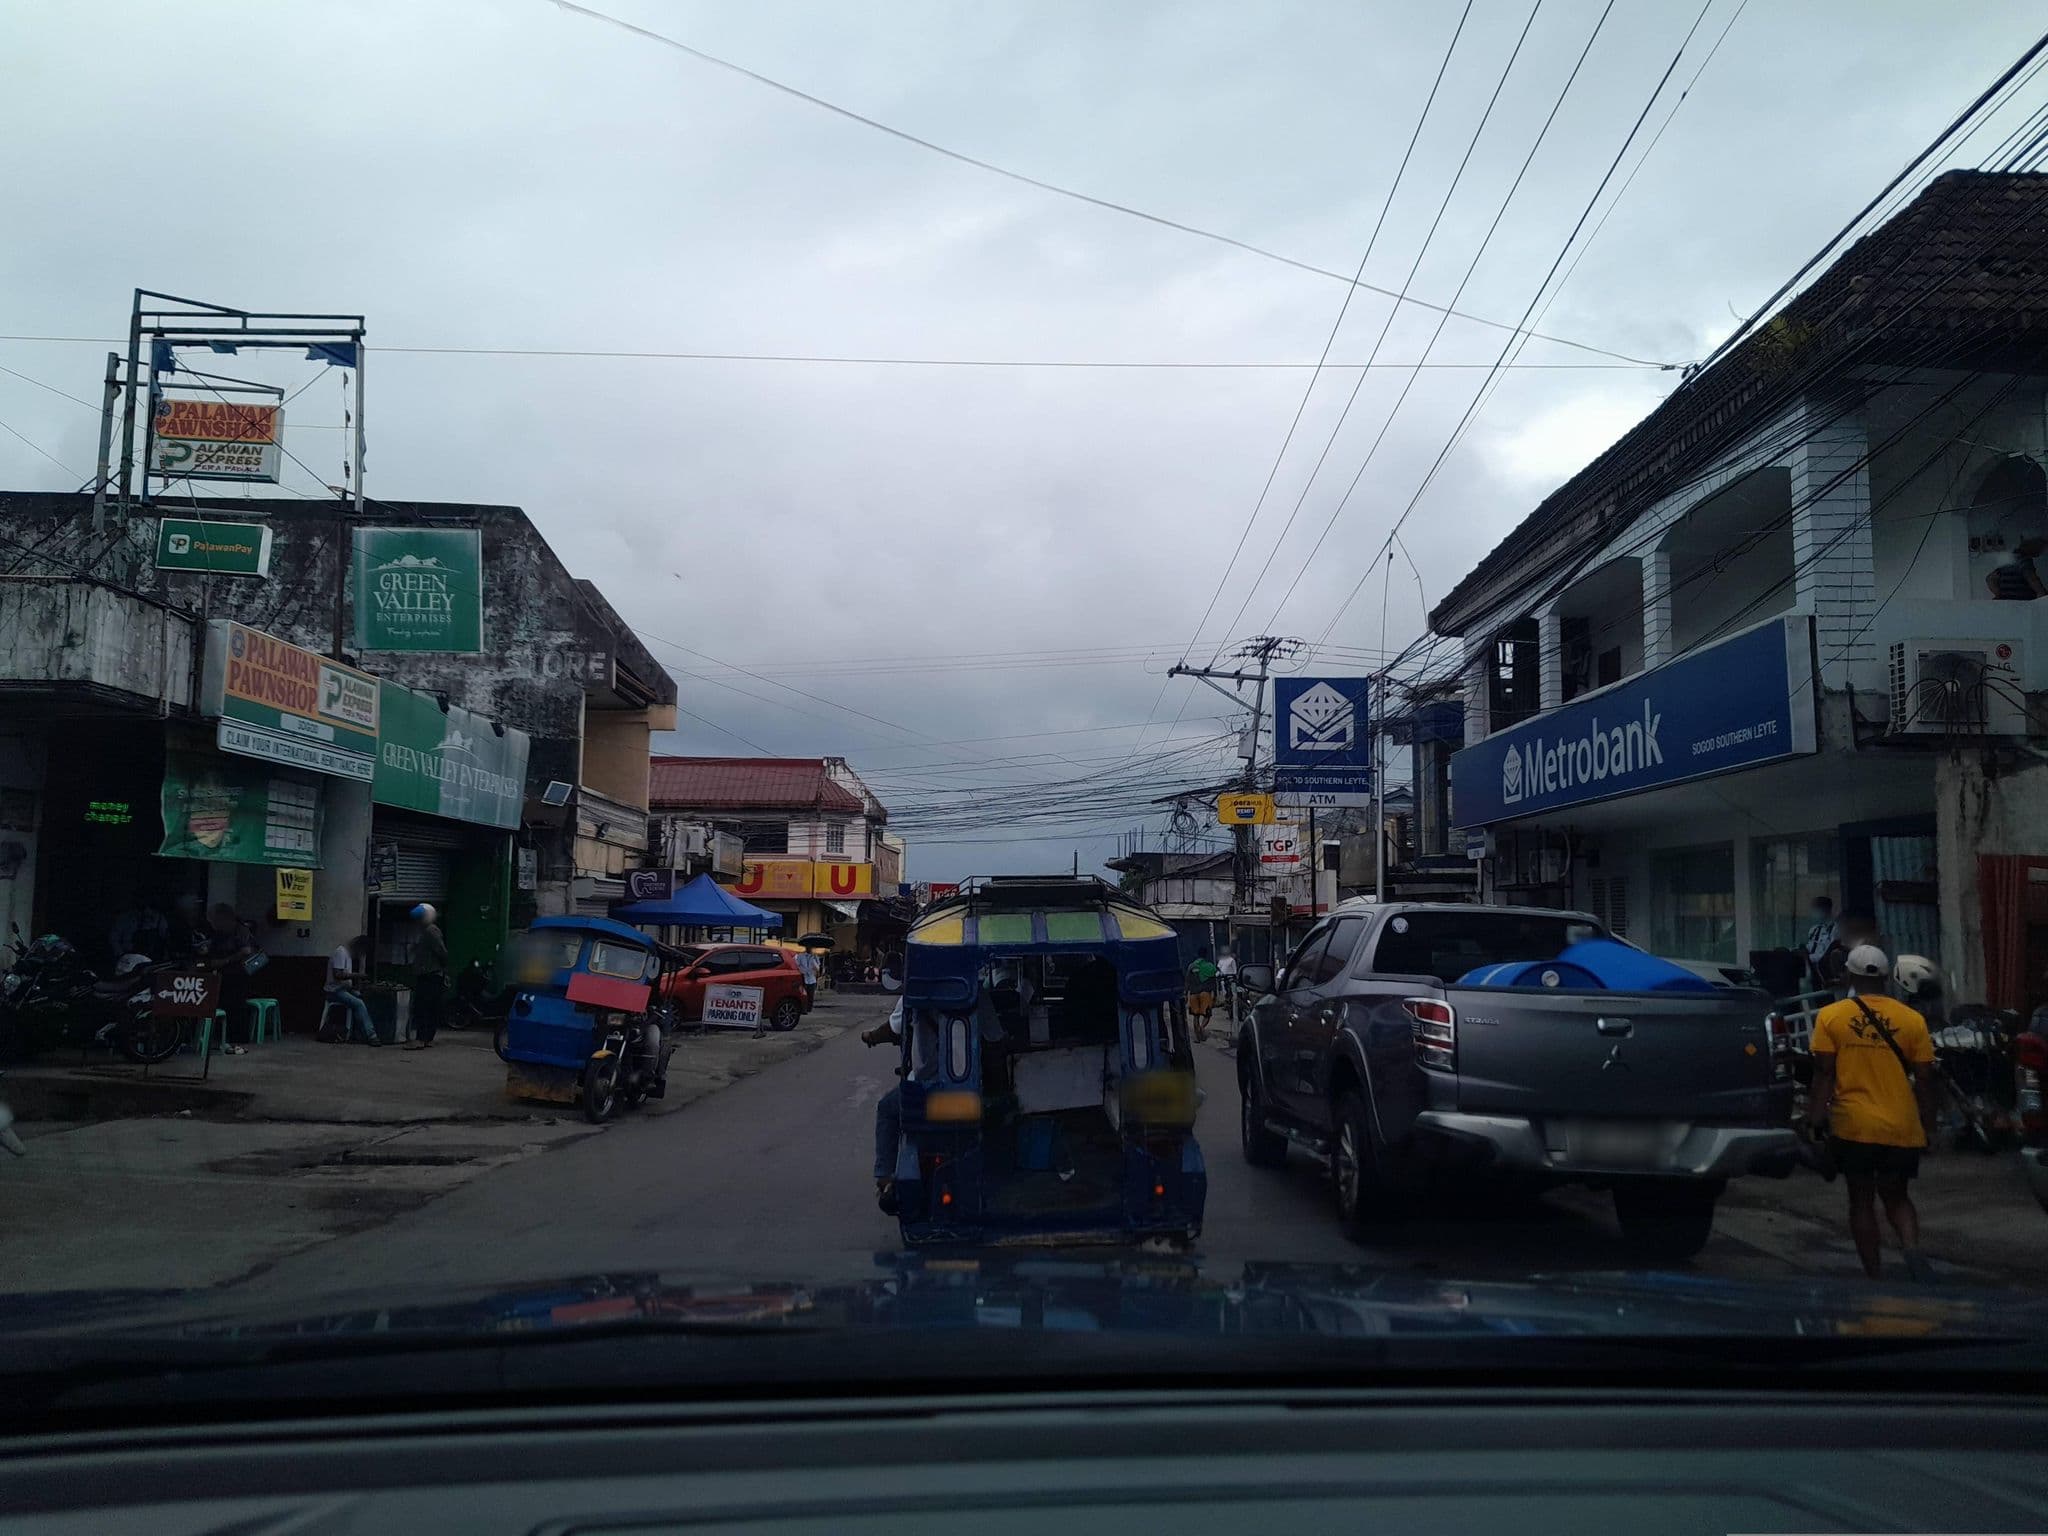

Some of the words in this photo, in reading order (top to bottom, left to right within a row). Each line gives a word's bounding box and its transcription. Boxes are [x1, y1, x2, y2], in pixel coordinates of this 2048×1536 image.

[173, 402, 272, 423] PALAWAN
[155, 417, 272, 440] PAWNSHOP
[193, 541, 252, 554] PalawanPay
[379, 573, 448, 592] GREEN
[373, 591, 455, 611] VALLEY
[376, 612, 452, 624] ENTERPRISES
[246, 632, 320, 684] PALAWAN
[229, 660, 318, 713] PAWNSHOP
[226, 730, 250, 748] CLAIM
[1525, 698, 1664, 798] Metrobank
[1692, 739, 1716, 756] SOGOD
[1716, 726, 1753, 749] SOUTHERN
[1754, 720, 1777, 739] LEYTE
[383, 742, 418, 773] GREEN
[419, 751, 457, 783] VALLEY
[1304, 776, 1343, 785] SOUTHERN
[1344, 776, 1367, 785] LEYTE
[1309, 795, 1336, 804] ATM
[1265, 840, 1293, 852] TGP
[831, 865, 856, 894] U
[173, 976, 205, 991] ONE
[173, 990, 208, 1005] WAY
[710, 999, 756, 1011] TENANTS
[708, 1009, 737, 1021] PARKING
[738, 1011, 757, 1022] ONLY
